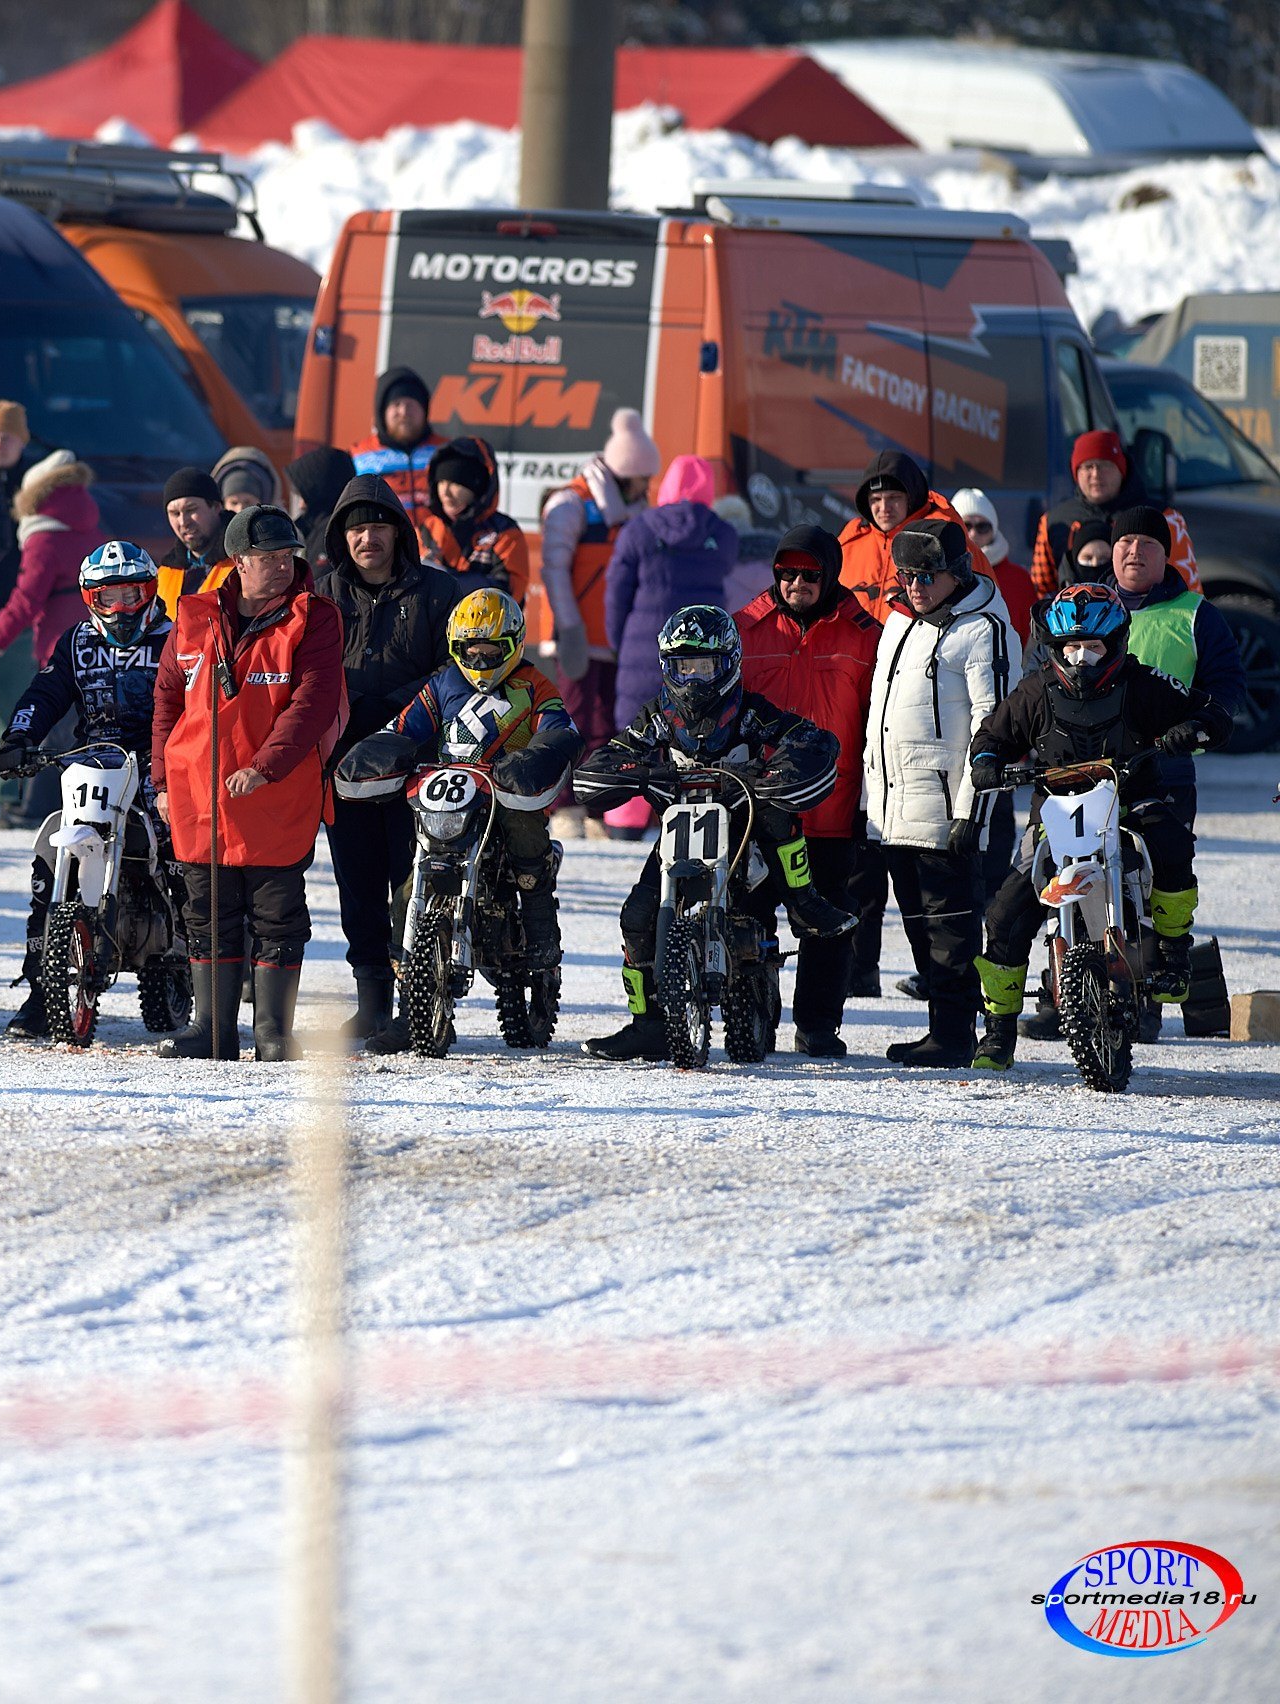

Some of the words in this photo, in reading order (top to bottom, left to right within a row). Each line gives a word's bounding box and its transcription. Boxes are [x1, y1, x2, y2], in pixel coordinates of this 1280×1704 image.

[410, 252, 638, 288] MOTOCROSS
[473, 335, 514, 363] Red
[516, 335, 562, 364] Bull
[763, 300, 837, 381] KTM
[428, 363, 602, 430] KTM
[841, 354, 929, 416] FACTORY
[931, 388, 1001, 442] RACING
[77, 783, 109, 811] 14
[426, 771, 469, 803] 68
[666, 808, 720, 863] 11
[1070, 804, 1084, 838] 1
